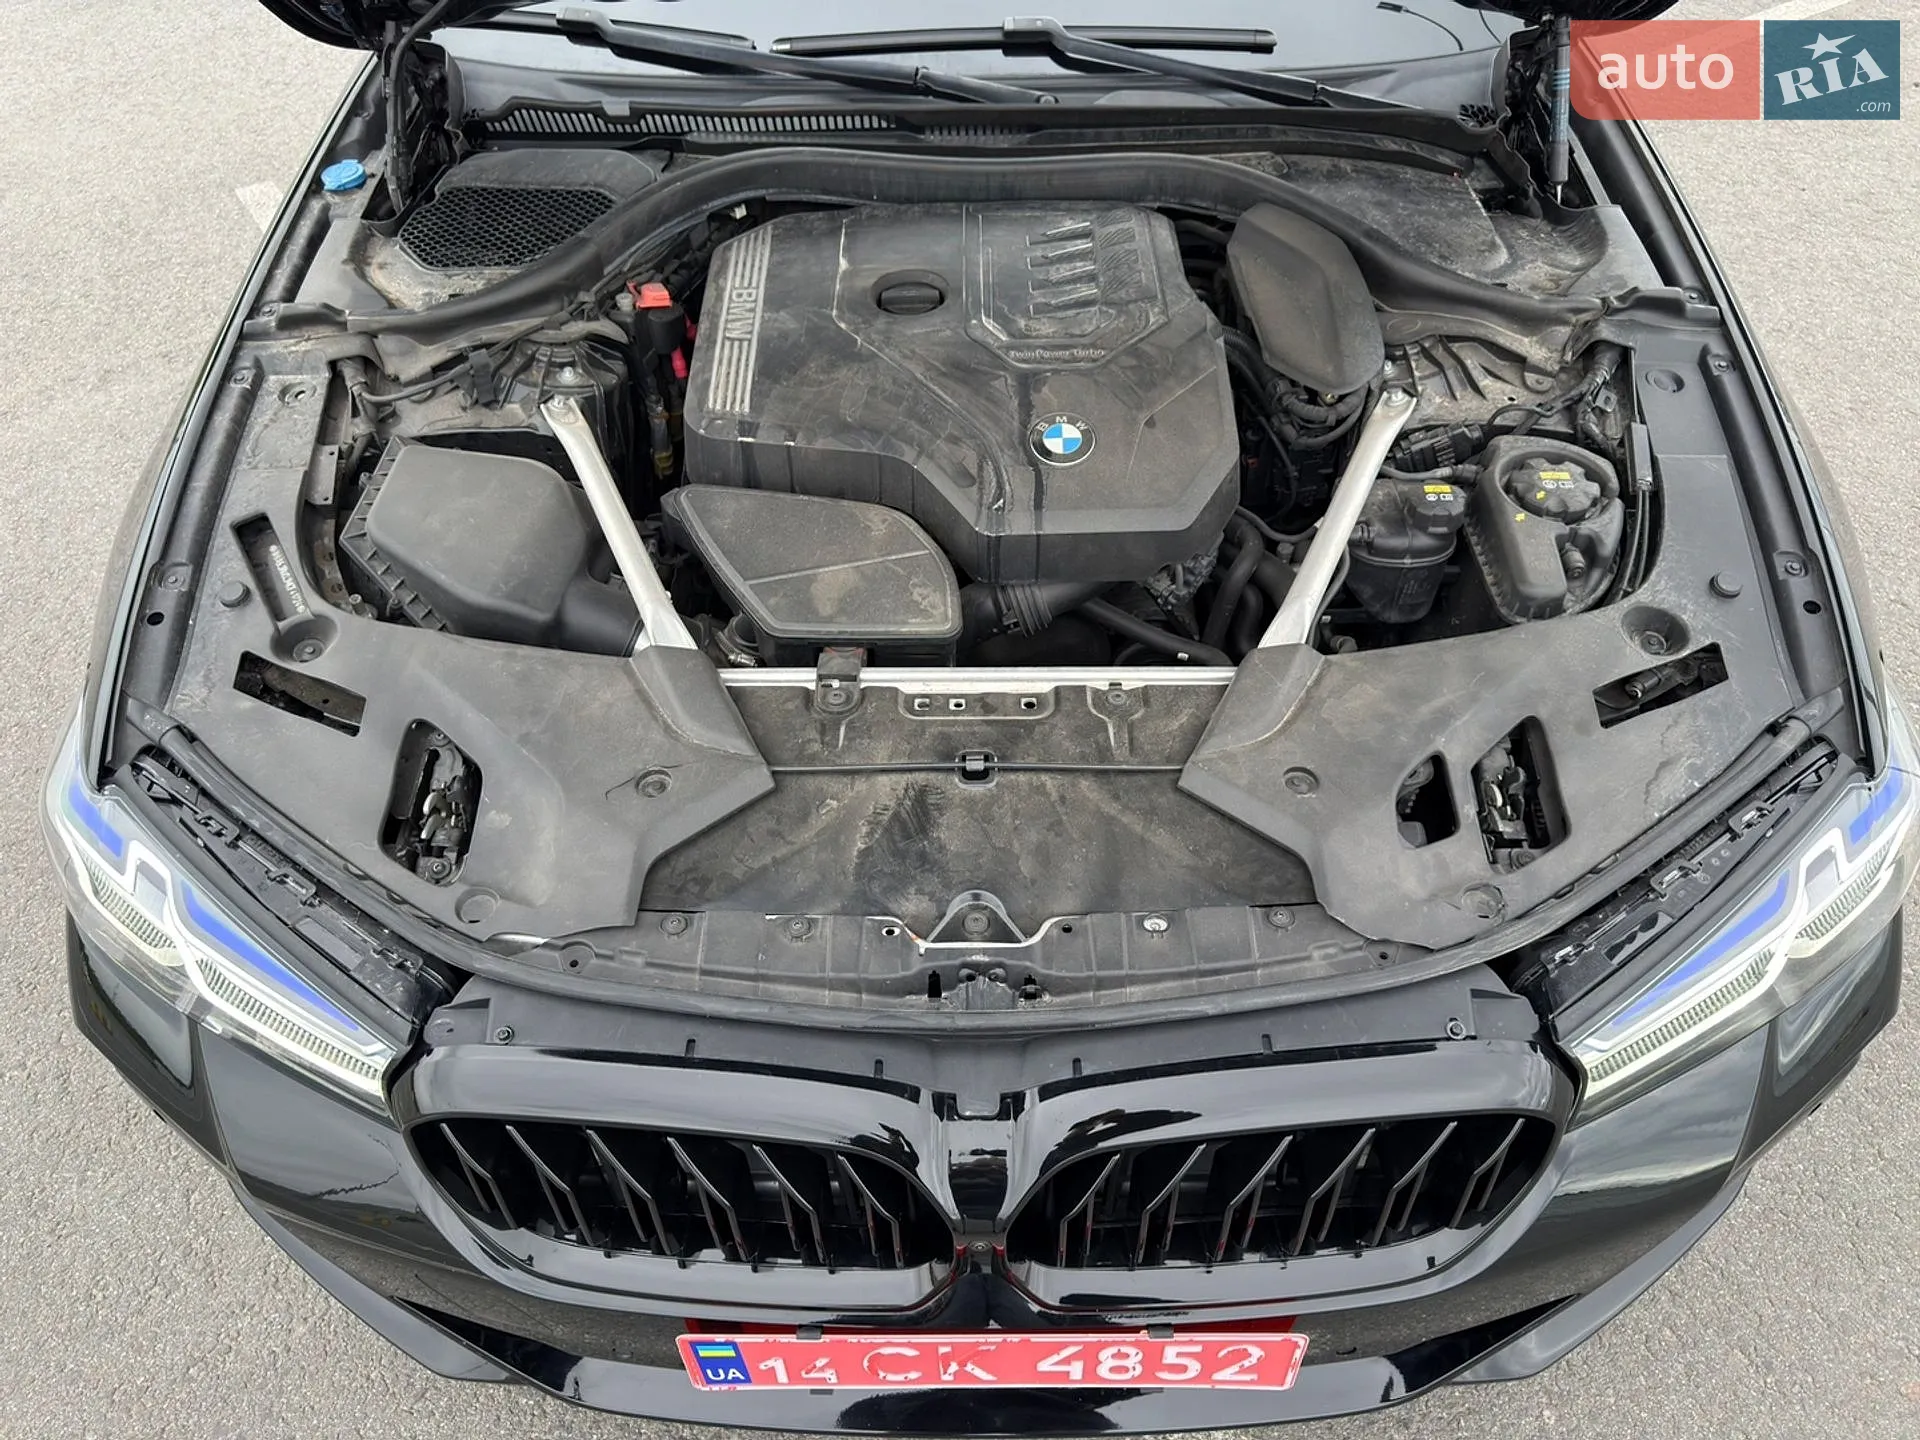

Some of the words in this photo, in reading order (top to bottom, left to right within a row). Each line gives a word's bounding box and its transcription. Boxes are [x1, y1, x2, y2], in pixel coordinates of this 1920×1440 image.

[725, 288, 757, 340] BMW
[1036, 416, 1088, 431] BMW
[706, 1368, 746, 1382] UA
[758, 1357, 839, 1384] 14
[862, 1345, 998, 1381] CK
[1036, 1344, 1265, 1381] 4852
